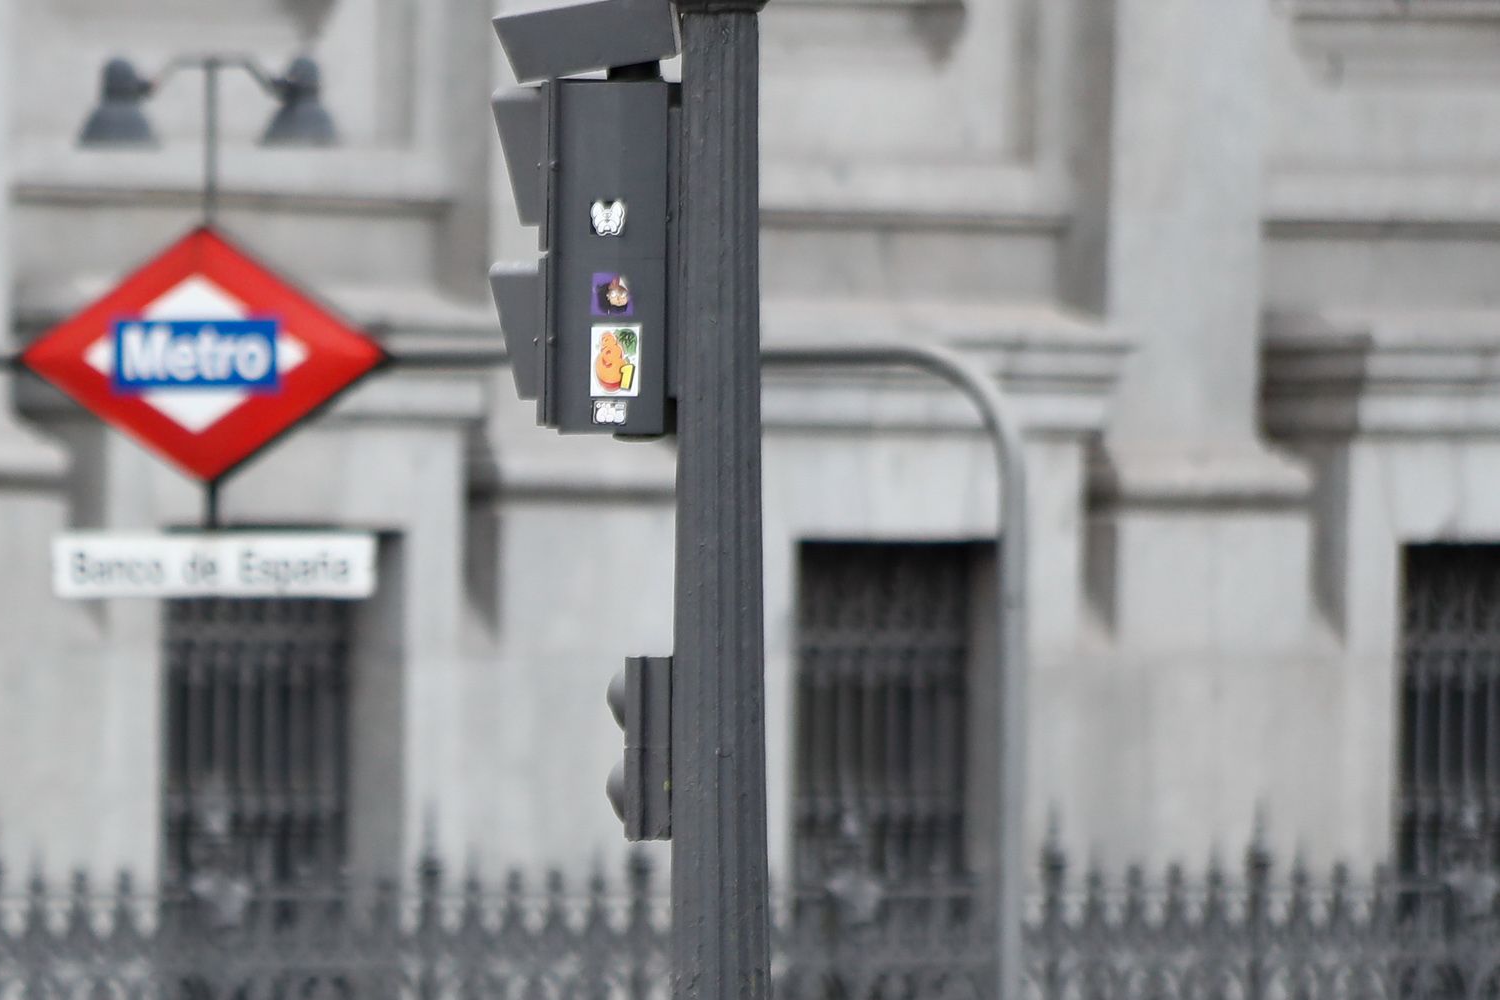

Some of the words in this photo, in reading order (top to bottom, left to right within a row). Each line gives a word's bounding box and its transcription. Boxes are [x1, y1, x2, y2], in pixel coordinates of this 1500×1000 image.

[120, 322, 272, 382] Metro
[71, 551, 164, 583] Banco
[182, 551, 219, 583] de
[237, 550, 353, 593] España
